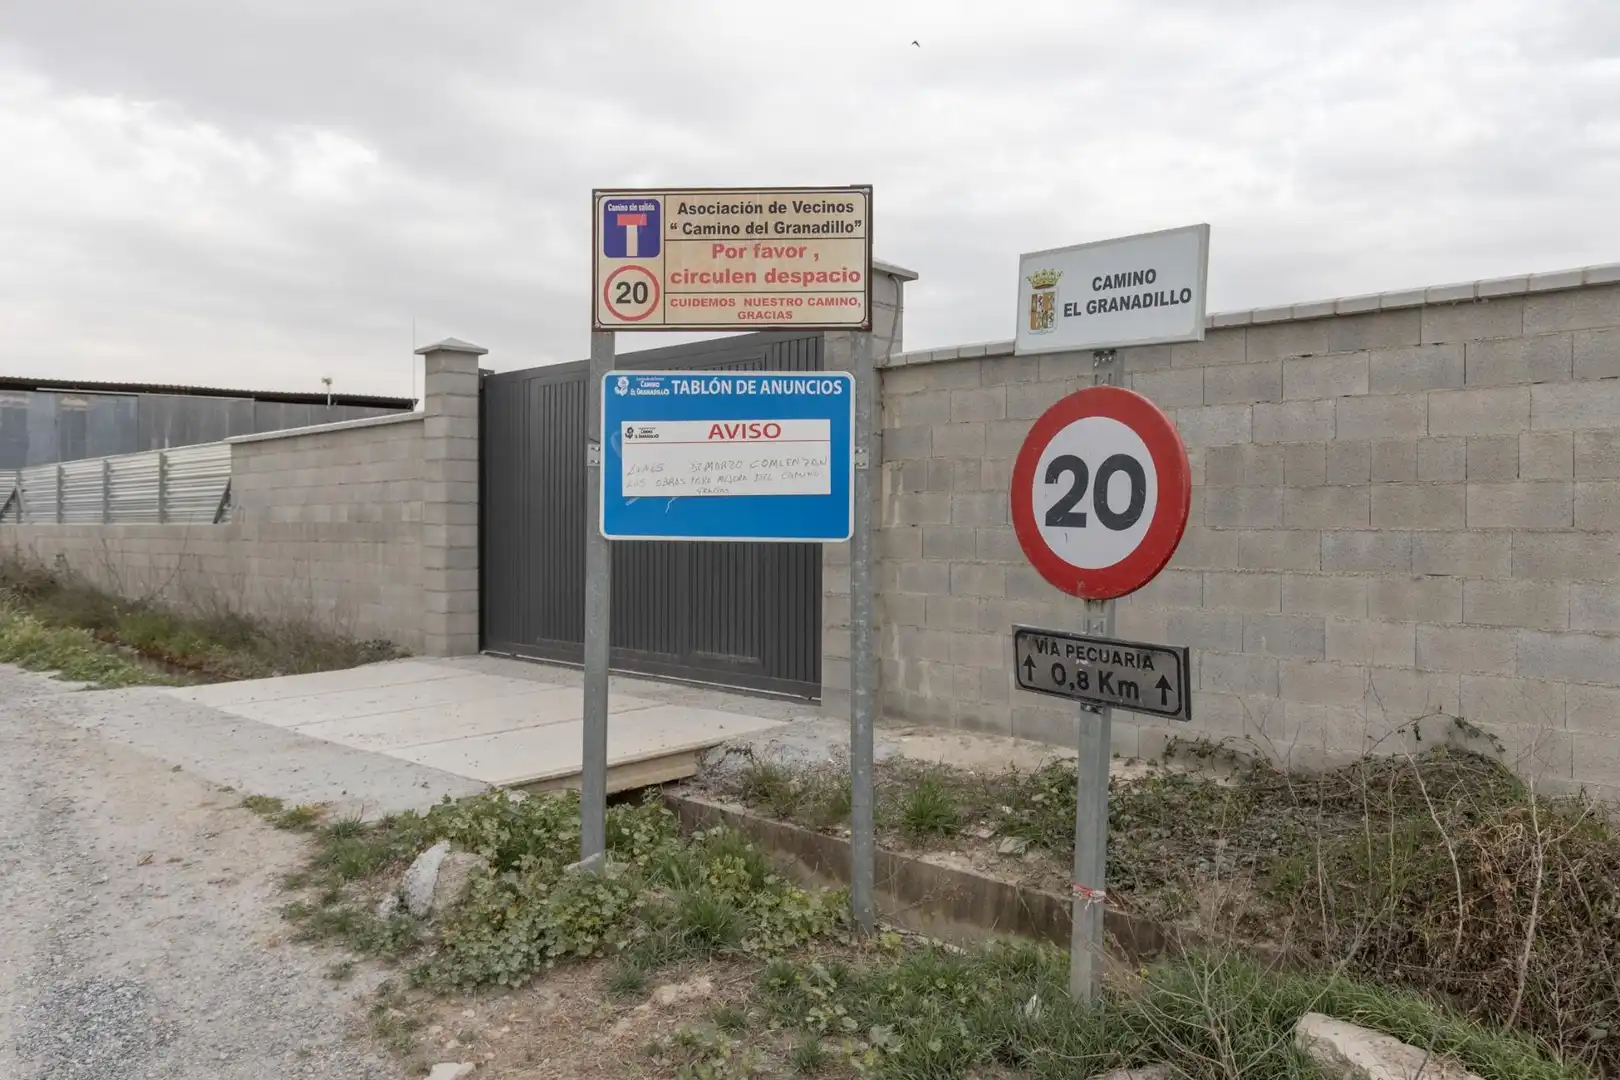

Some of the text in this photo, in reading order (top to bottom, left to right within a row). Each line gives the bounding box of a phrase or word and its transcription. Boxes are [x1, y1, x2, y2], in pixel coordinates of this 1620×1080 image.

[608, 201, 655, 211] Camino sin salida
[677, 200, 854, 215] Asociación de Vecinos
[745, 221, 769, 234] del
[712, 243, 747, 259] Por
[670, 267, 861, 287] circulen despacio
[1092, 268, 1157, 292] CAMINO
[615, 281, 649, 305] 20
[670, 297, 862, 308] CUIDEMOS NUESTRO CAMINO,
[1063, 287, 1192, 318] EL GRANADILLO
[737, 310, 793, 320] GRACIAS
[671, 377, 843, 395] TABLÓN DE ANUNCIOS
[708, 423, 782, 440] AVISO
[1044, 453, 1147, 532] 20
[1066, 643, 1155, 672] PECUARIA
[1051, 662, 1140, 701] 0,8 Km
